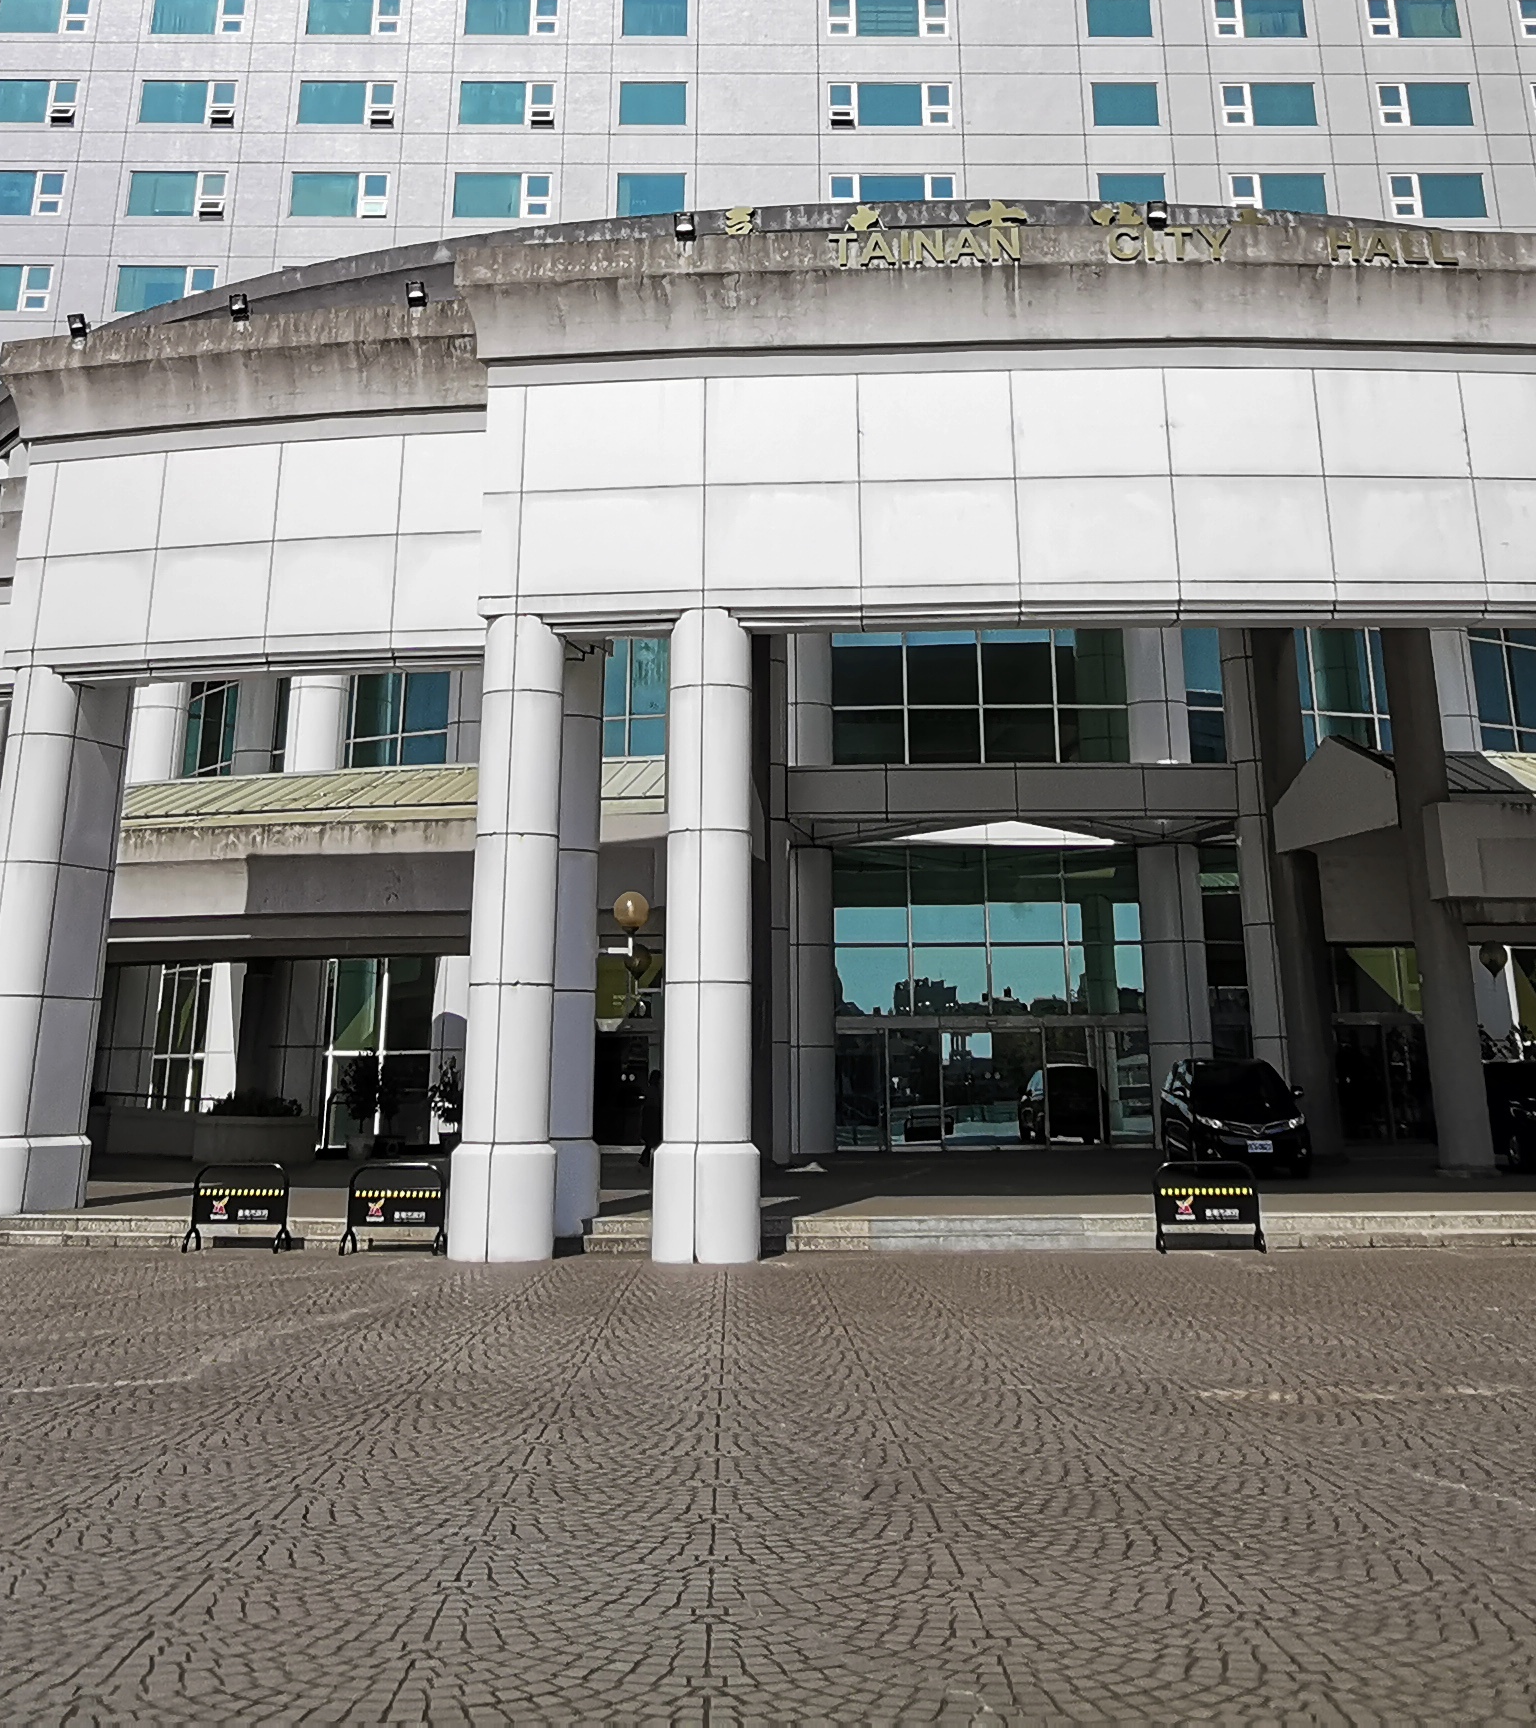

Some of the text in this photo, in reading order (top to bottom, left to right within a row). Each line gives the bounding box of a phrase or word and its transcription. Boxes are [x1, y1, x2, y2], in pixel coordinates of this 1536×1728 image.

[828, 226, 1460, 267] TAINAN CITY HALL
